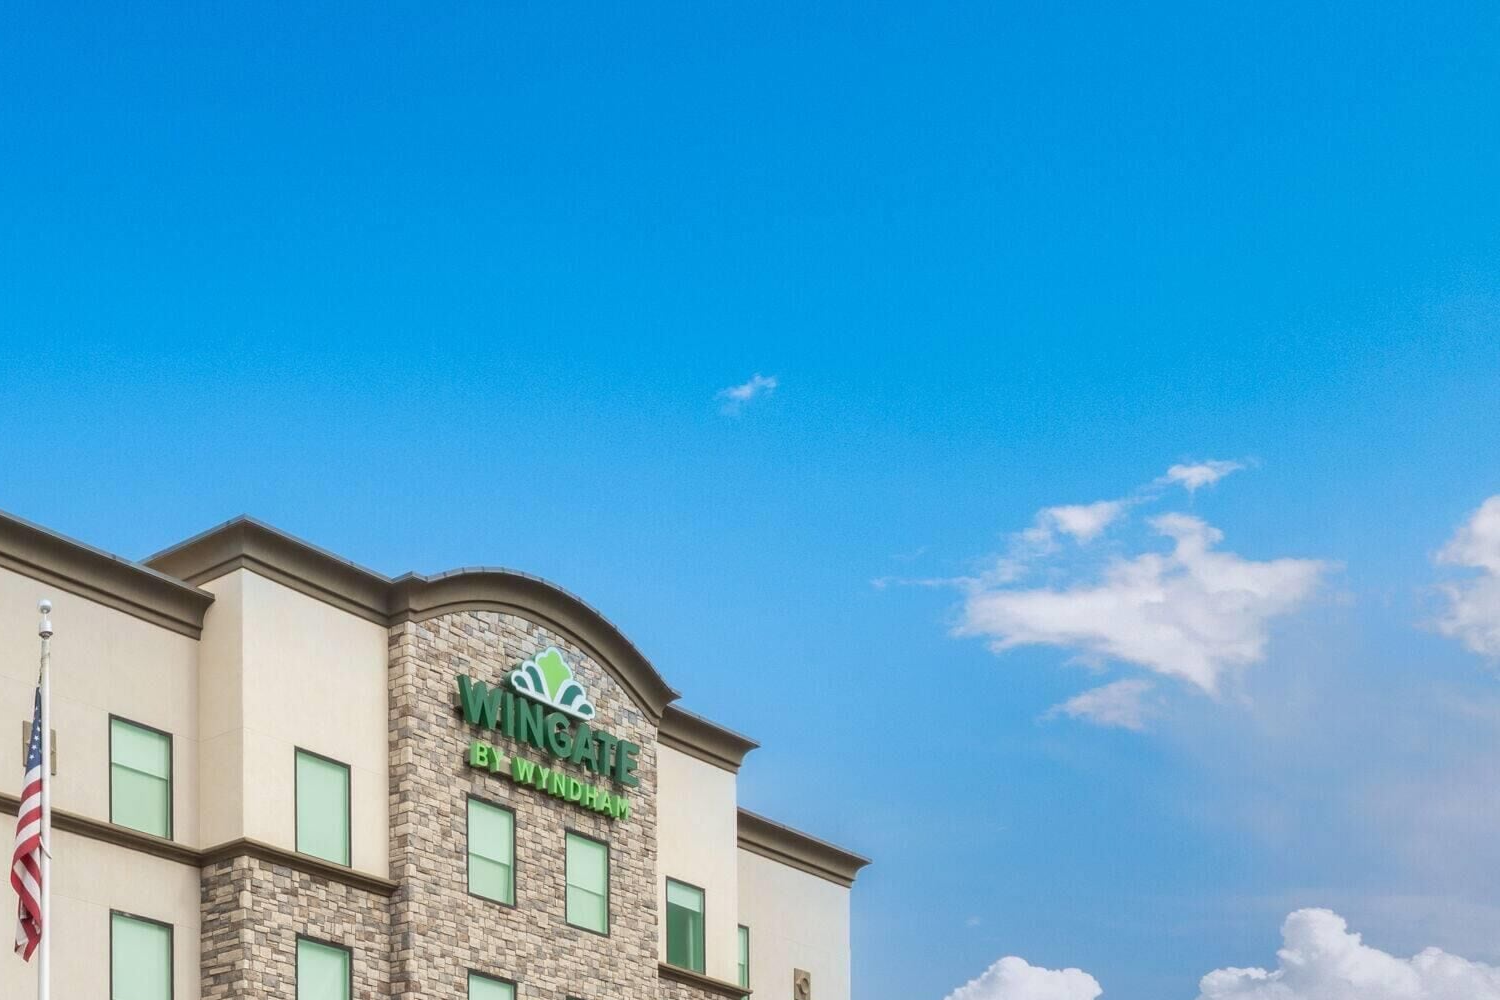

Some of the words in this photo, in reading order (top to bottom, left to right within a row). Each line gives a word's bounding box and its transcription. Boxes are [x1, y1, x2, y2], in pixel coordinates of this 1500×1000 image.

[457, 674, 640, 787] WINGATE
[470, 742, 503, 773] BY
[511, 756, 630, 820] WYNDHAM
